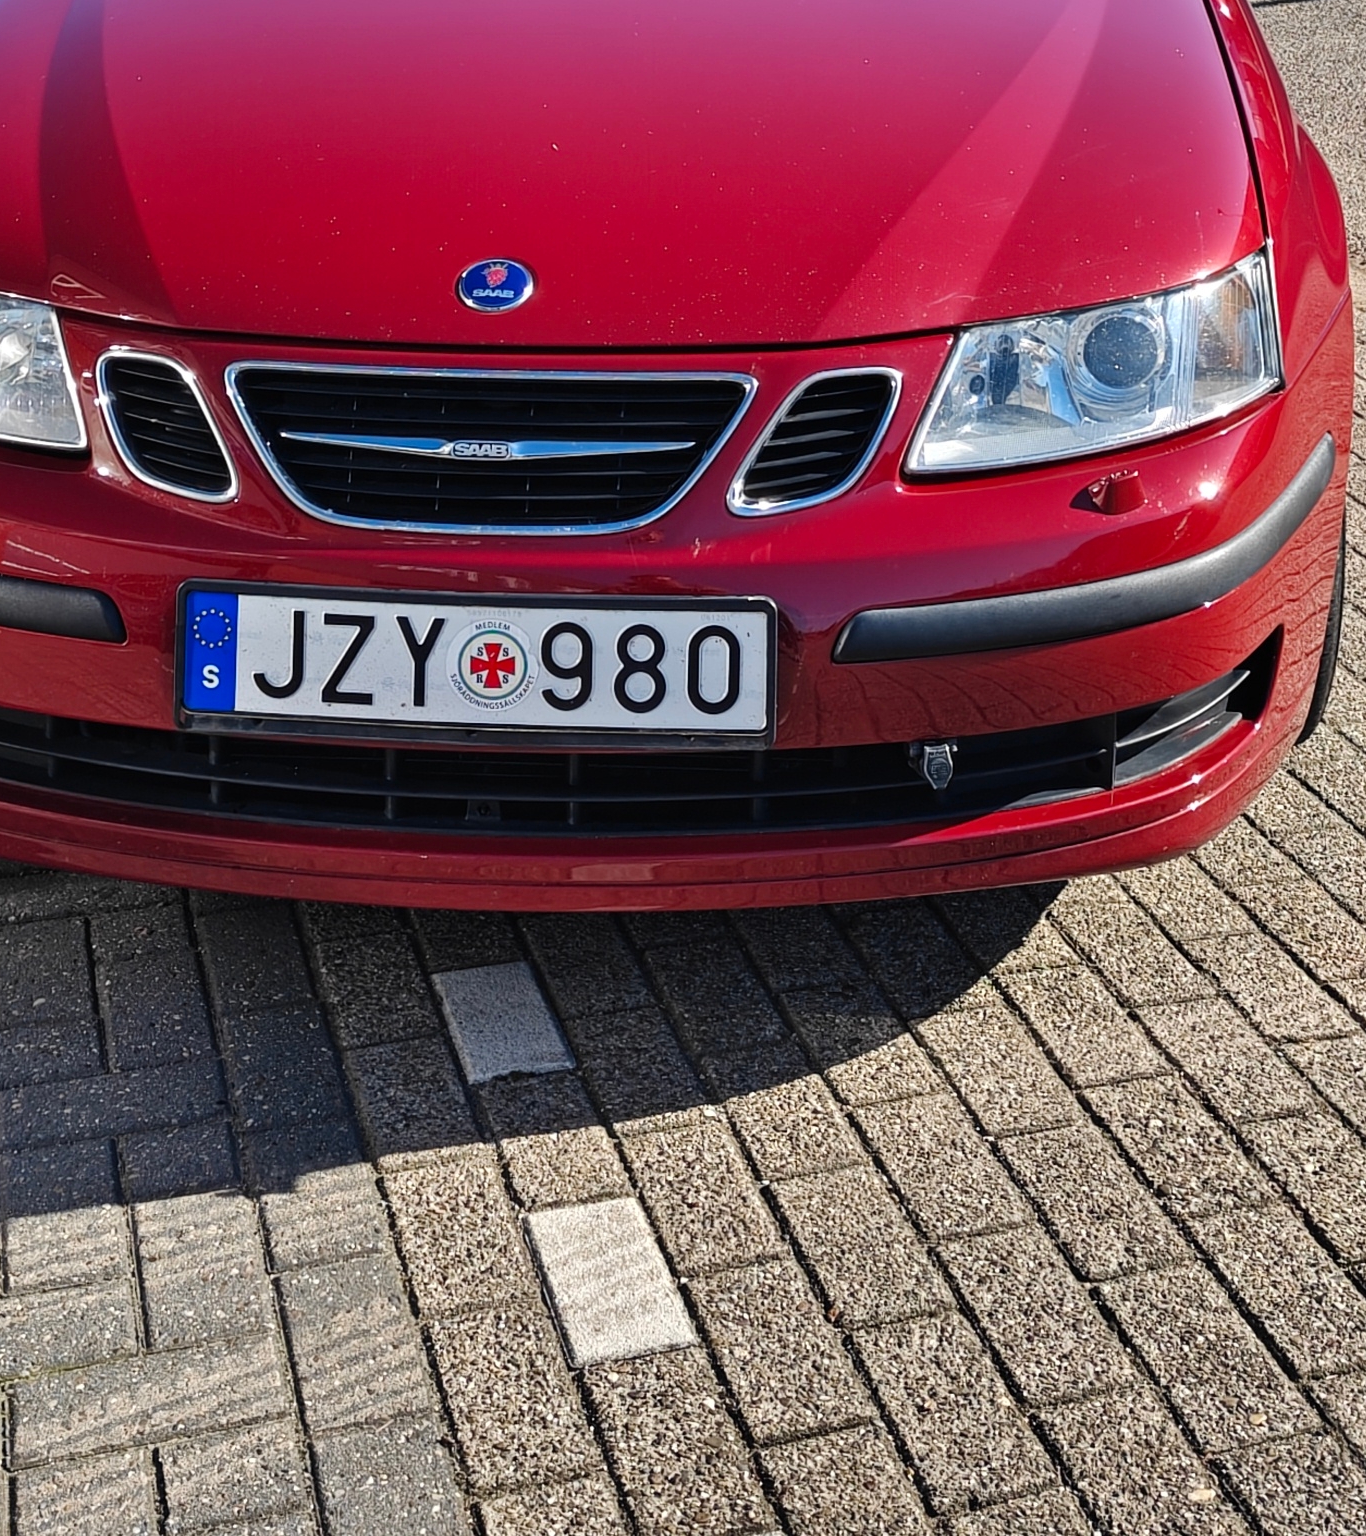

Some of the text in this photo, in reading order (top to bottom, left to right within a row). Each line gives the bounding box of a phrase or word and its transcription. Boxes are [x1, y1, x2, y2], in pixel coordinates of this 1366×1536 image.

[472, 289, 515, 299] SAAB
[454, 443, 509, 457] SAAB
[475, 621, 511, 631] MEDLEM
[477, 647, 509, 657] S S
[252, 610, 741, 715] JZY 980
[202, 664, 220, 689] S
[476, 673, 509, 684] R S
